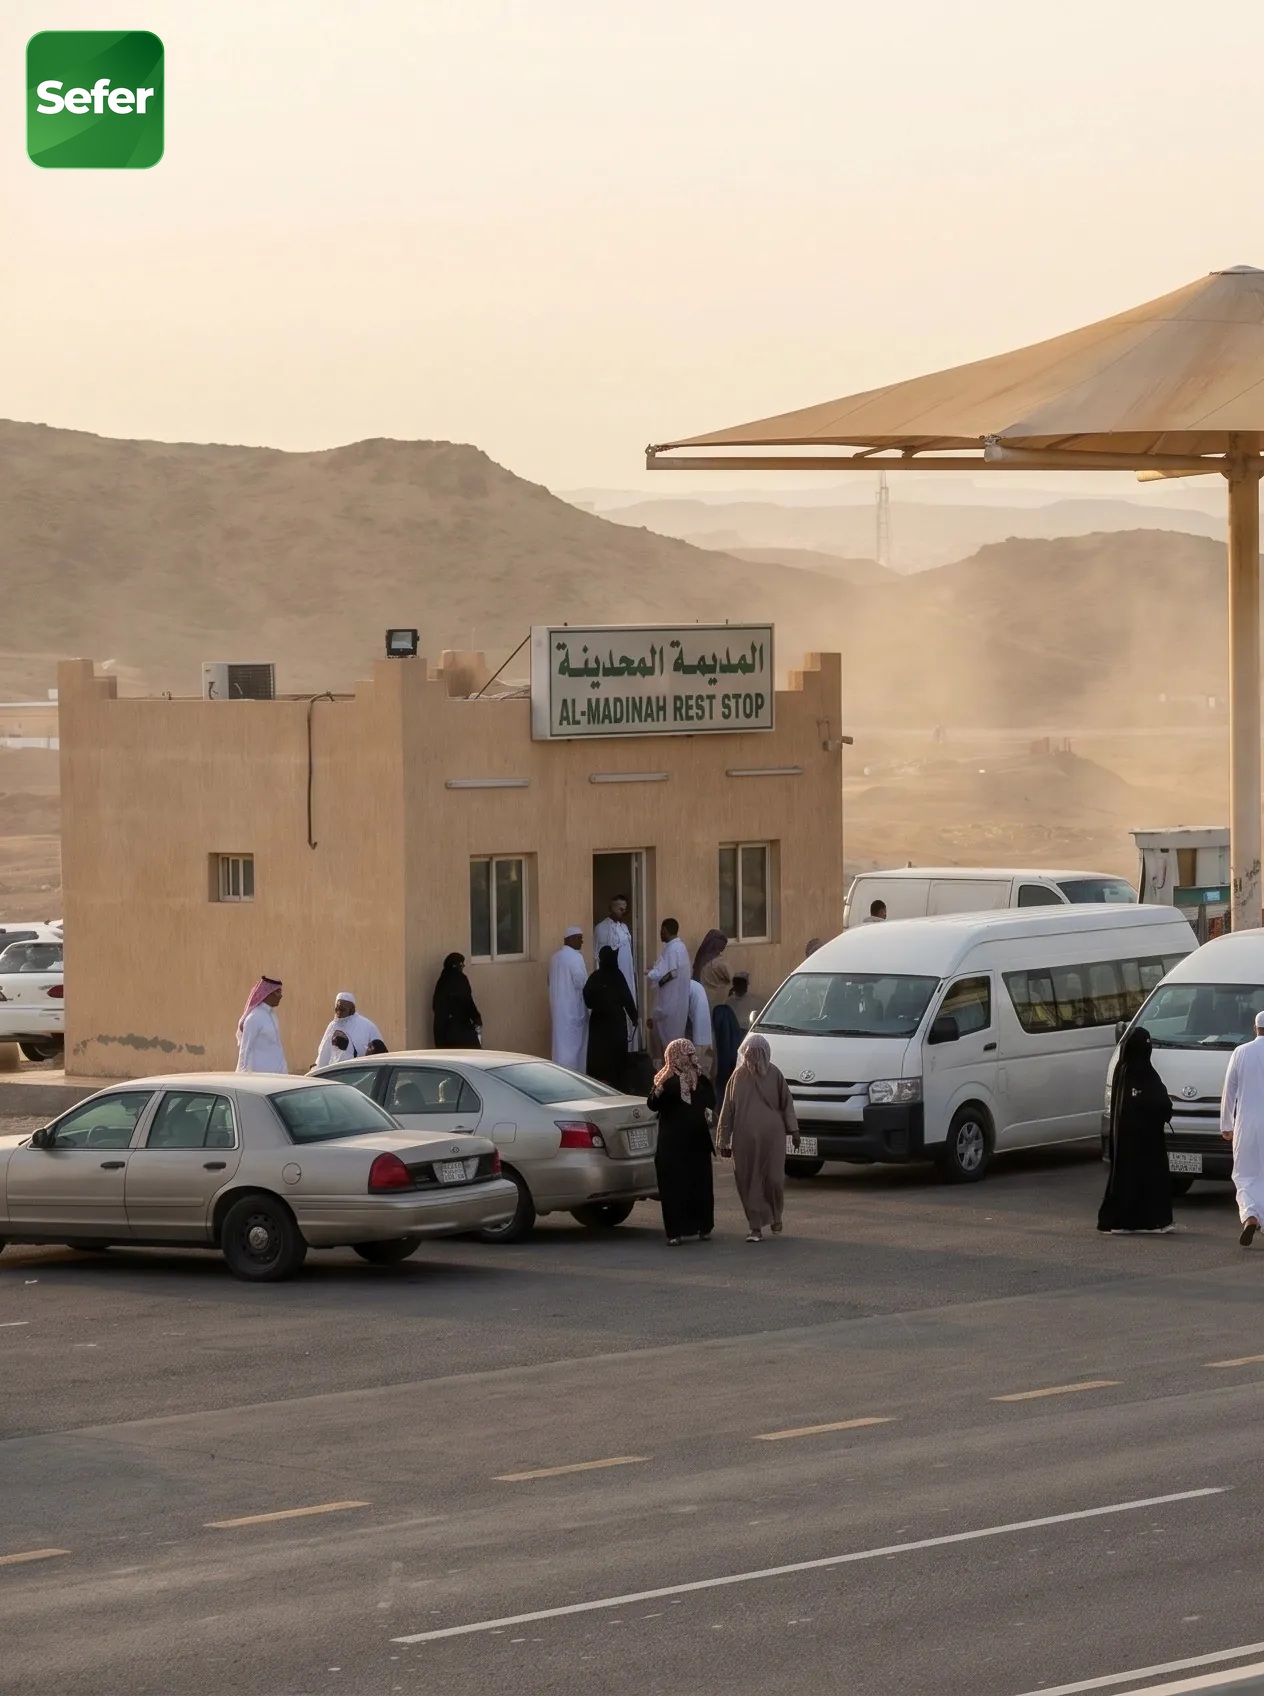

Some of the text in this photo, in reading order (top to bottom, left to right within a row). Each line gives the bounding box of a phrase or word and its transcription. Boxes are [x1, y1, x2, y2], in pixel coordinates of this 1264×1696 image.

[559, 693, 765, 726] AL-MADINAH REST STOP
